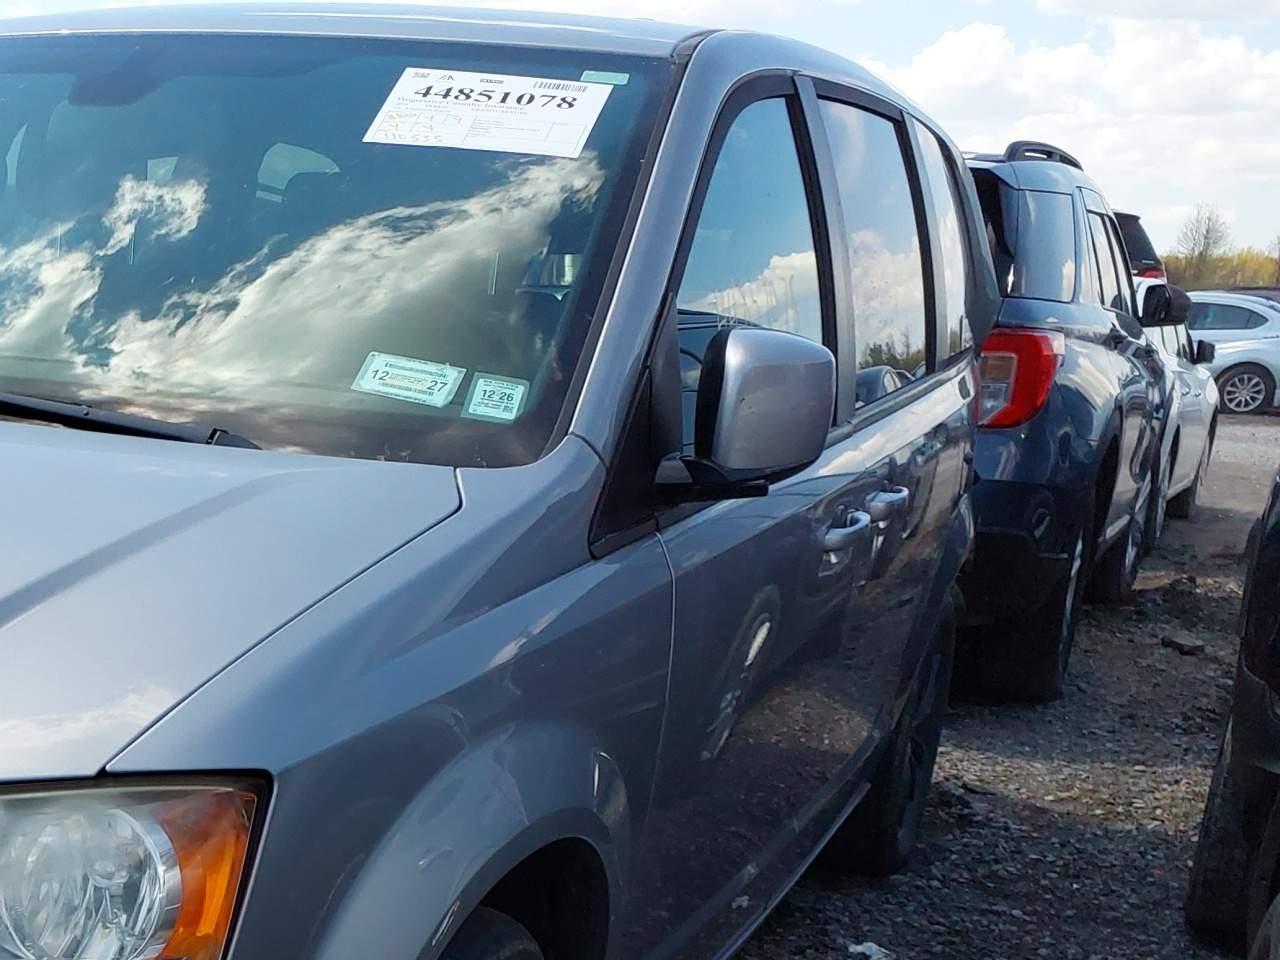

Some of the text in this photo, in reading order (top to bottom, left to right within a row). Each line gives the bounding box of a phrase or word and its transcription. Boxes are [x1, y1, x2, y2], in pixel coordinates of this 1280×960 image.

[414, 84, 577, 110] 44851078
[371, 369, 390, 382] 12
[426, 380, 449, 393] 27
